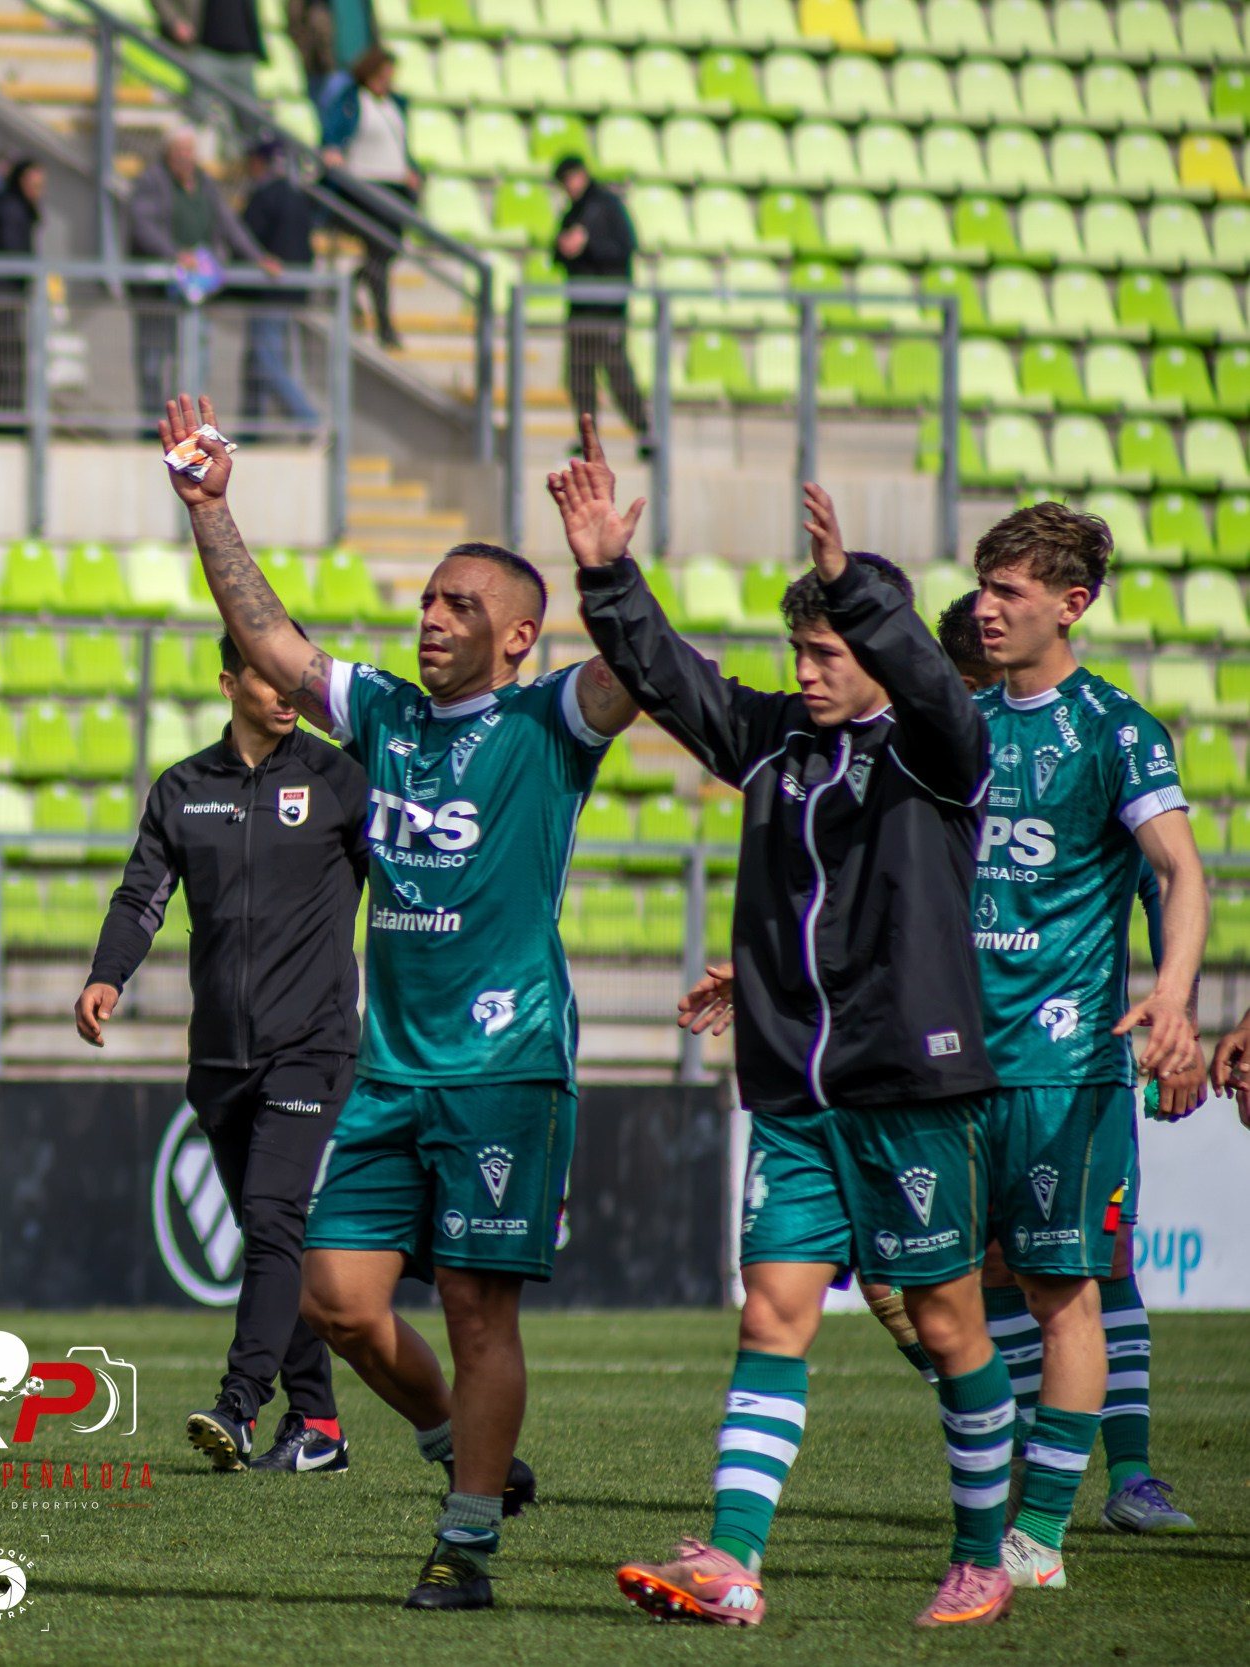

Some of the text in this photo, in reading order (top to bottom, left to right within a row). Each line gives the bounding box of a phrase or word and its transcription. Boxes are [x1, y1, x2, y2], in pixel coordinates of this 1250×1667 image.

[183, 801, 234, 814] marathon
[367, 787, 481, 851] TPS
[973, 927, 1040, 951] mwin
[470, 1218, 528, 1229] FOTON
[904, 1230, 960, 1248] FOTON
